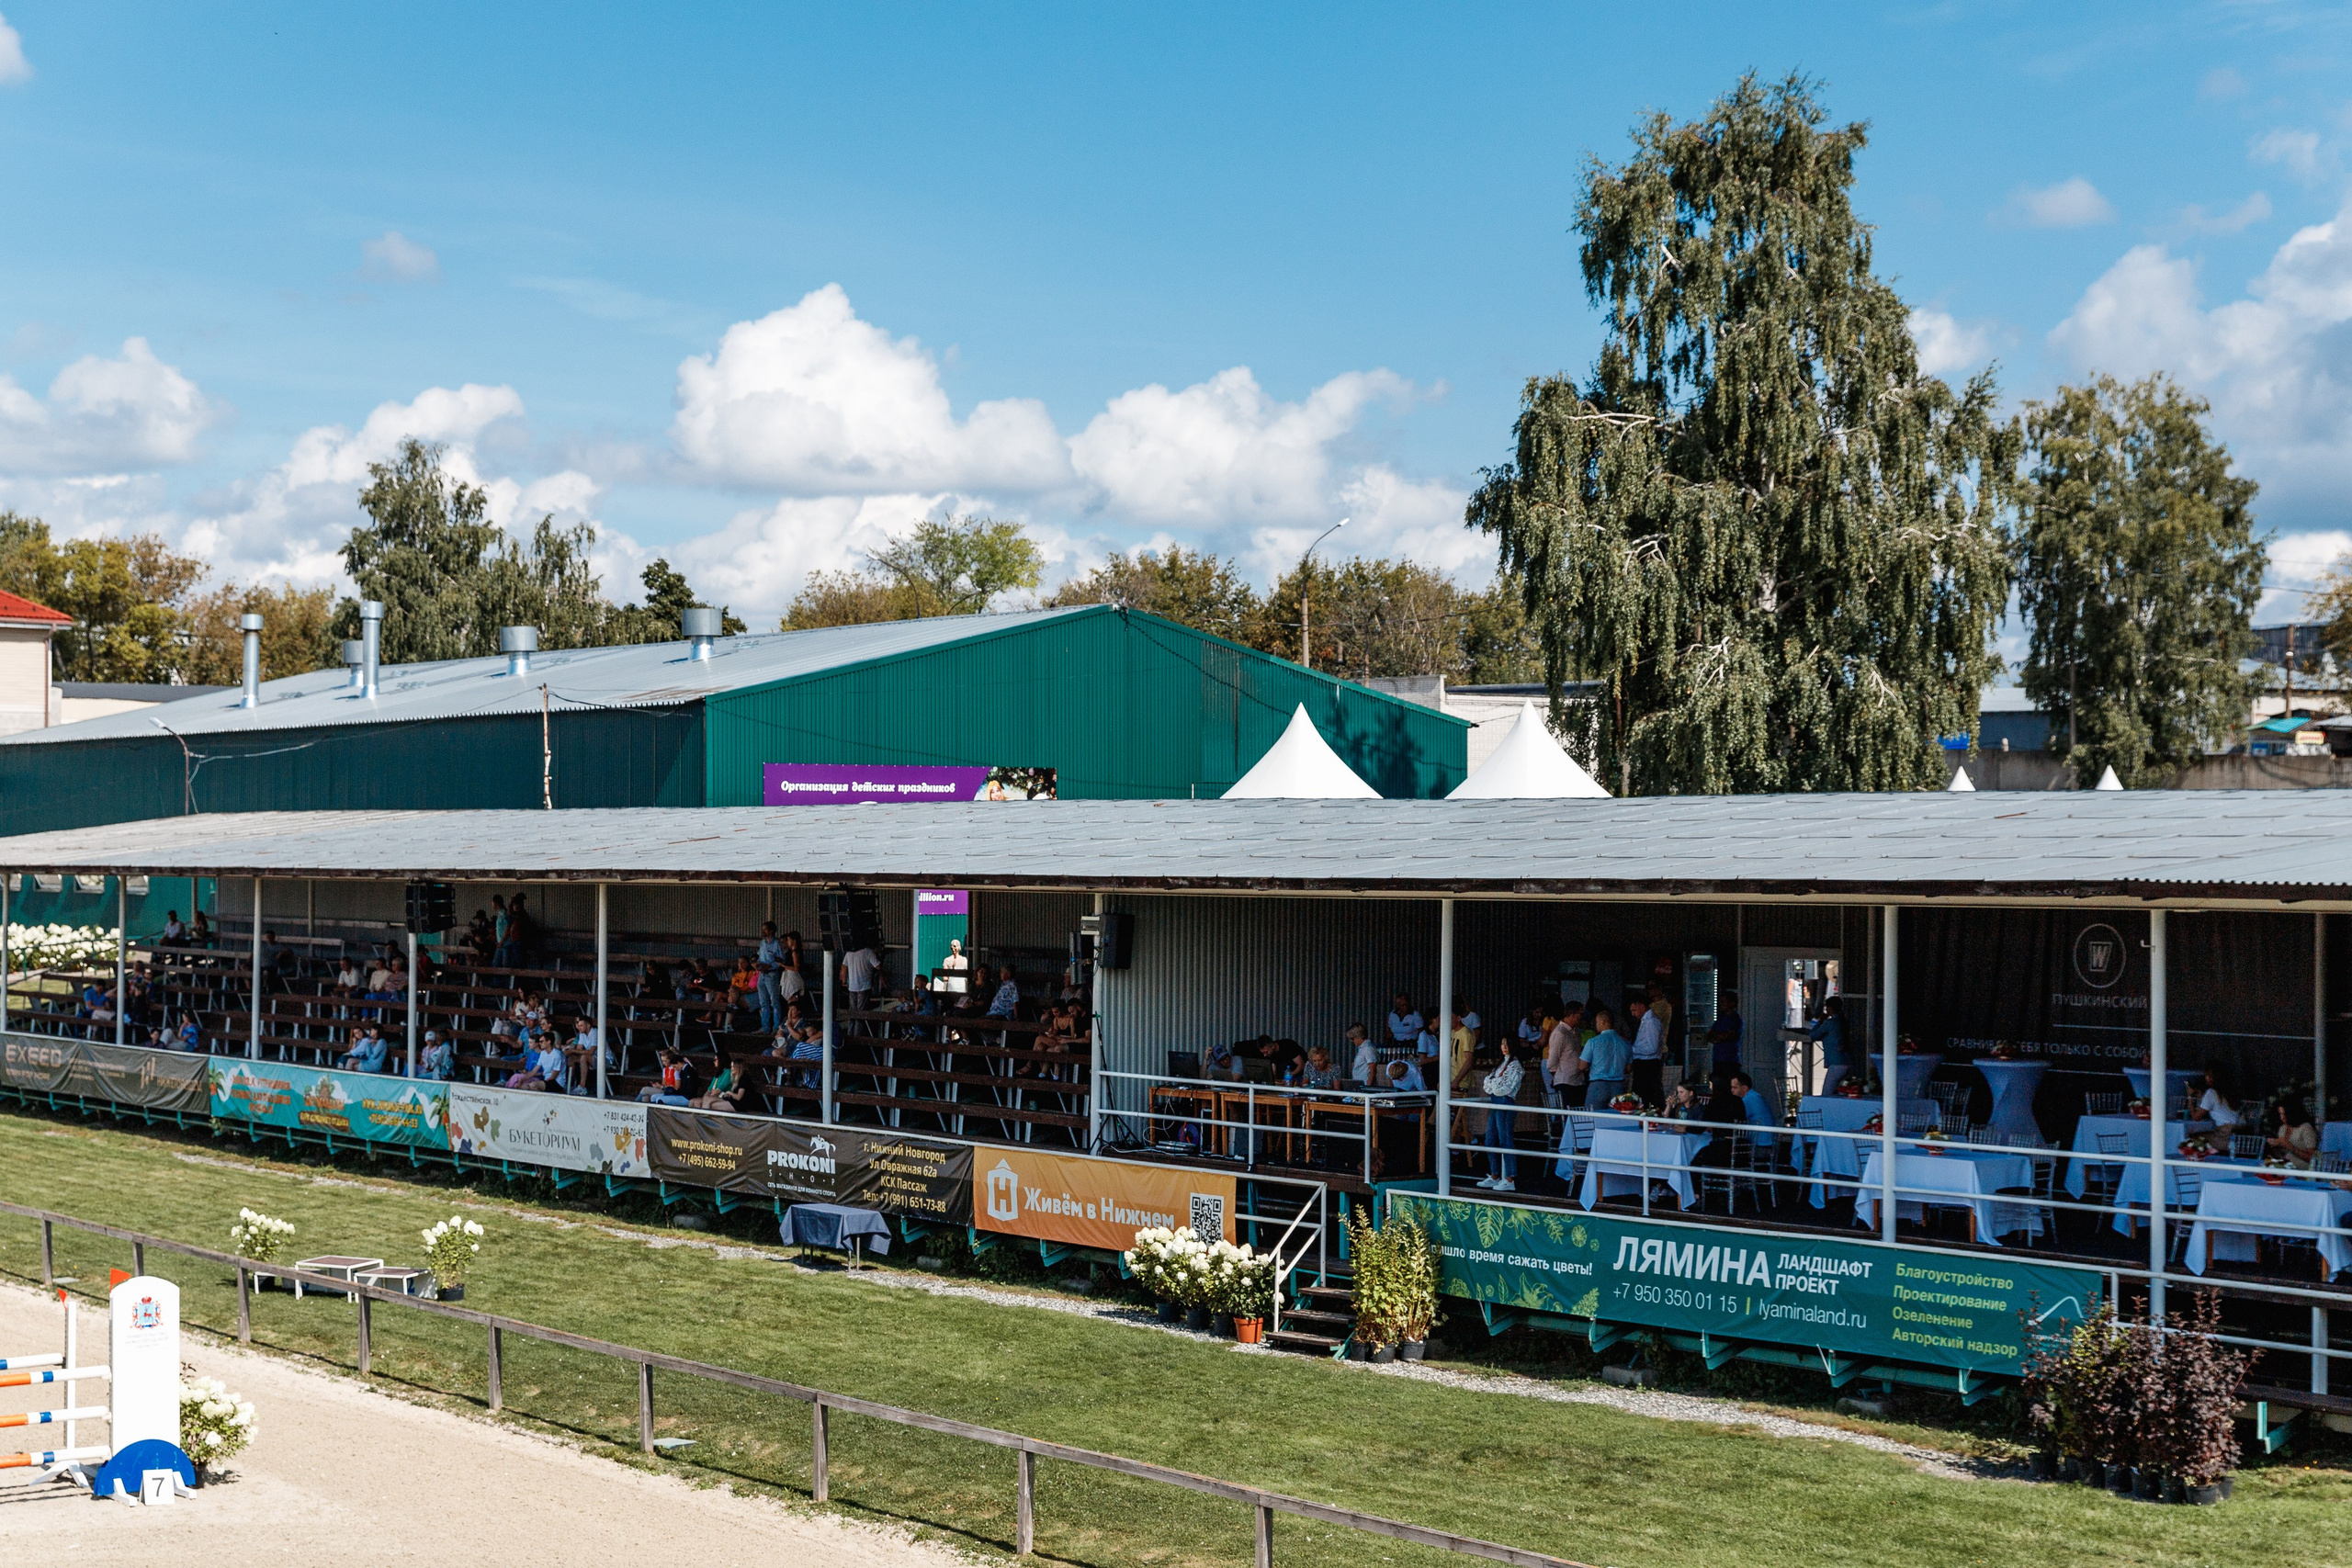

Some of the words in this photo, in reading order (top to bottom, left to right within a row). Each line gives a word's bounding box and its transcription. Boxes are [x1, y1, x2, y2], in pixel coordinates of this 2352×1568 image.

[781, 781, 848, 795] Организация
[851, 781, 895, 793] детских
[898, 782, 956, 794] праздников
[2052, 992, 2148, 1009] ПУШКИНСКИЙ
[6, 1043, 62, 1068] EXEED
[2017, 1041, 2041, 1054] ЕБЯ
[2043, 1043, 2091, 1056] ТОЛЬКО
[2093, 1045, 2101, 1056] С
[509, 1129, 581, 1152] БУКЕТОРИУМ
[671, 1137, 743, 1157] www.prokoni-shop.ru
[678, 1153, 686, 1164] +7
[687, 1154, 704, 1168] (495)
[704, 1157, 736, 1171] 662-59-94
[767, 1150, 836, 1174] PROKONI
[864, 1143, 869, 1153] г.
[870, 1142, 904, 1156] Нижний
[905, 1145, 946, 1165] Новгород
[869, 1158, 879, 1170] Ул
[880, 1159, 922, 1176] Овражная
[922, 1165, 938, 1179] 62а
[880, 1175, 896, 1189] КСК
[897, 1178, 928, 1193] Пассаж
[863, 1189, 878, 1202] Тел:
[879, 1192, 888, 1204] +7
[889, 1192, 909, 1209] (991)
[910, 1198, 947, 1213] 651-73-88
[1023, 1186, 1083, 1218] Живём
[1087, 1203, 1097, 1220] в
[1101, 1197, 1175, 1231] Нижнем
[1430, 1244, 1466, 1258] ришло
[1469, 1248, 1505, 1264] время
[1507, 1254, 1550, 1270] сажать
[1553, 1259, 1593, 1276] цветы!
[1612, 1235, 1772, 1289] ЛЯМИНА
[1777, 1253, 1873, 1279] ЛАНДШАФТ
[1774, 1274, 1840, 1296] ПРОЕКТ
[1895, 1262, 2014, 1290] Благоустройство
[1612, 1282, 1631, 1299] +7
[1634, 1284, 1662, 1304] 950
[1664, 1289, 1692, 1308] 350
[1695, 1292, 1713, 1311] 01
[1719, 1295, 1737, 1314] 15
[1893, 1285, 2007, 1312] Проектирование
[1758, 1298, 1867, 1329] lyaminaland.ru
[1892, 1306, 1973, 1329] Озеленение
[1892, 1327, 1964, 1350] Авторский
[1966, 1340, 2018, 1359] надзор
[152, 1477, 165, 1497] 7
